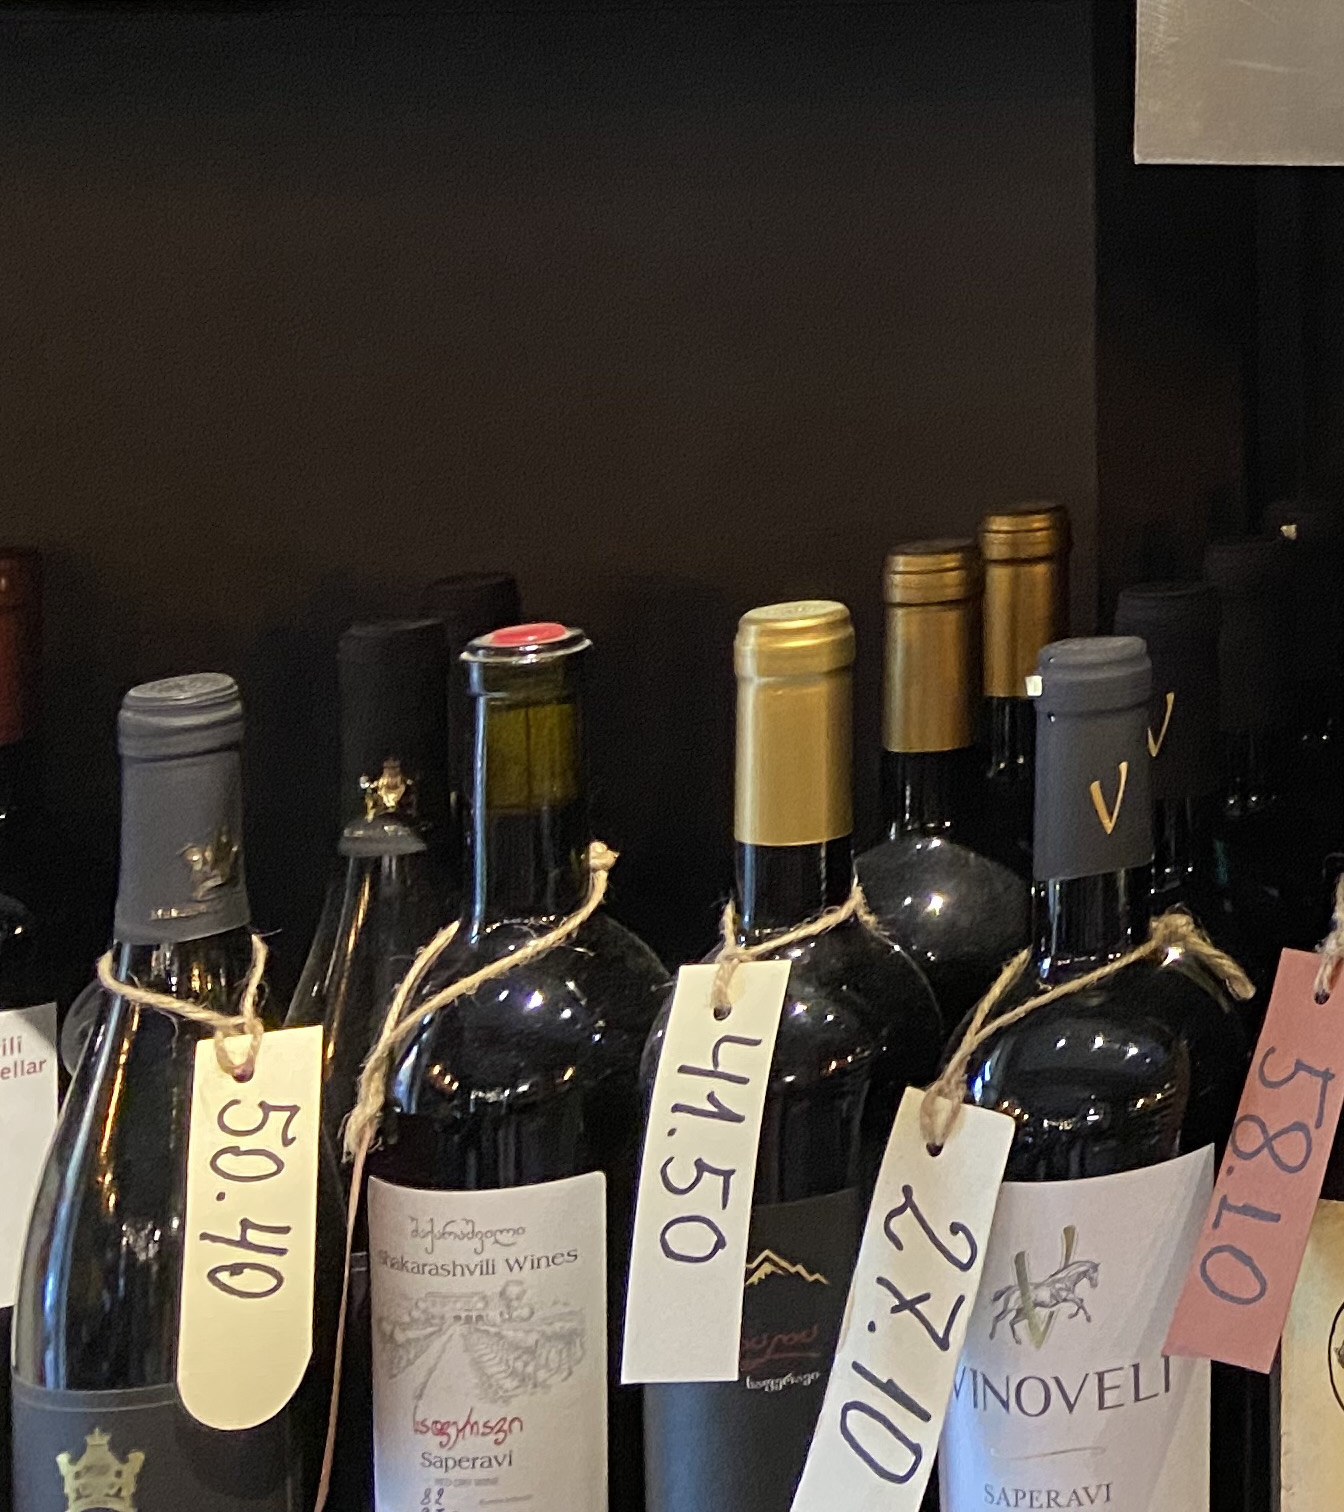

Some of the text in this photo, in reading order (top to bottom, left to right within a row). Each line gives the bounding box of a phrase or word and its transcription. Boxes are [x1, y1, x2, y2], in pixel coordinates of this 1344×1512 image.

[0, 1057, 47, 1080] ellar
[659, 1034, 763, 1264] 41.50
[1200, 1046, 1335, 1306] 58.10
[199, 1099, 301, 1299] 50.40
[505, 1248, 579, 1273] Wines
[840, 1185, 978, 1485] 27.10
[952, 1355, 1172, 1418] VINOVELI
[420, 1449, 513, 1473] Saperavi
[983, 1481, 1114, 1510] SAPERAVI
